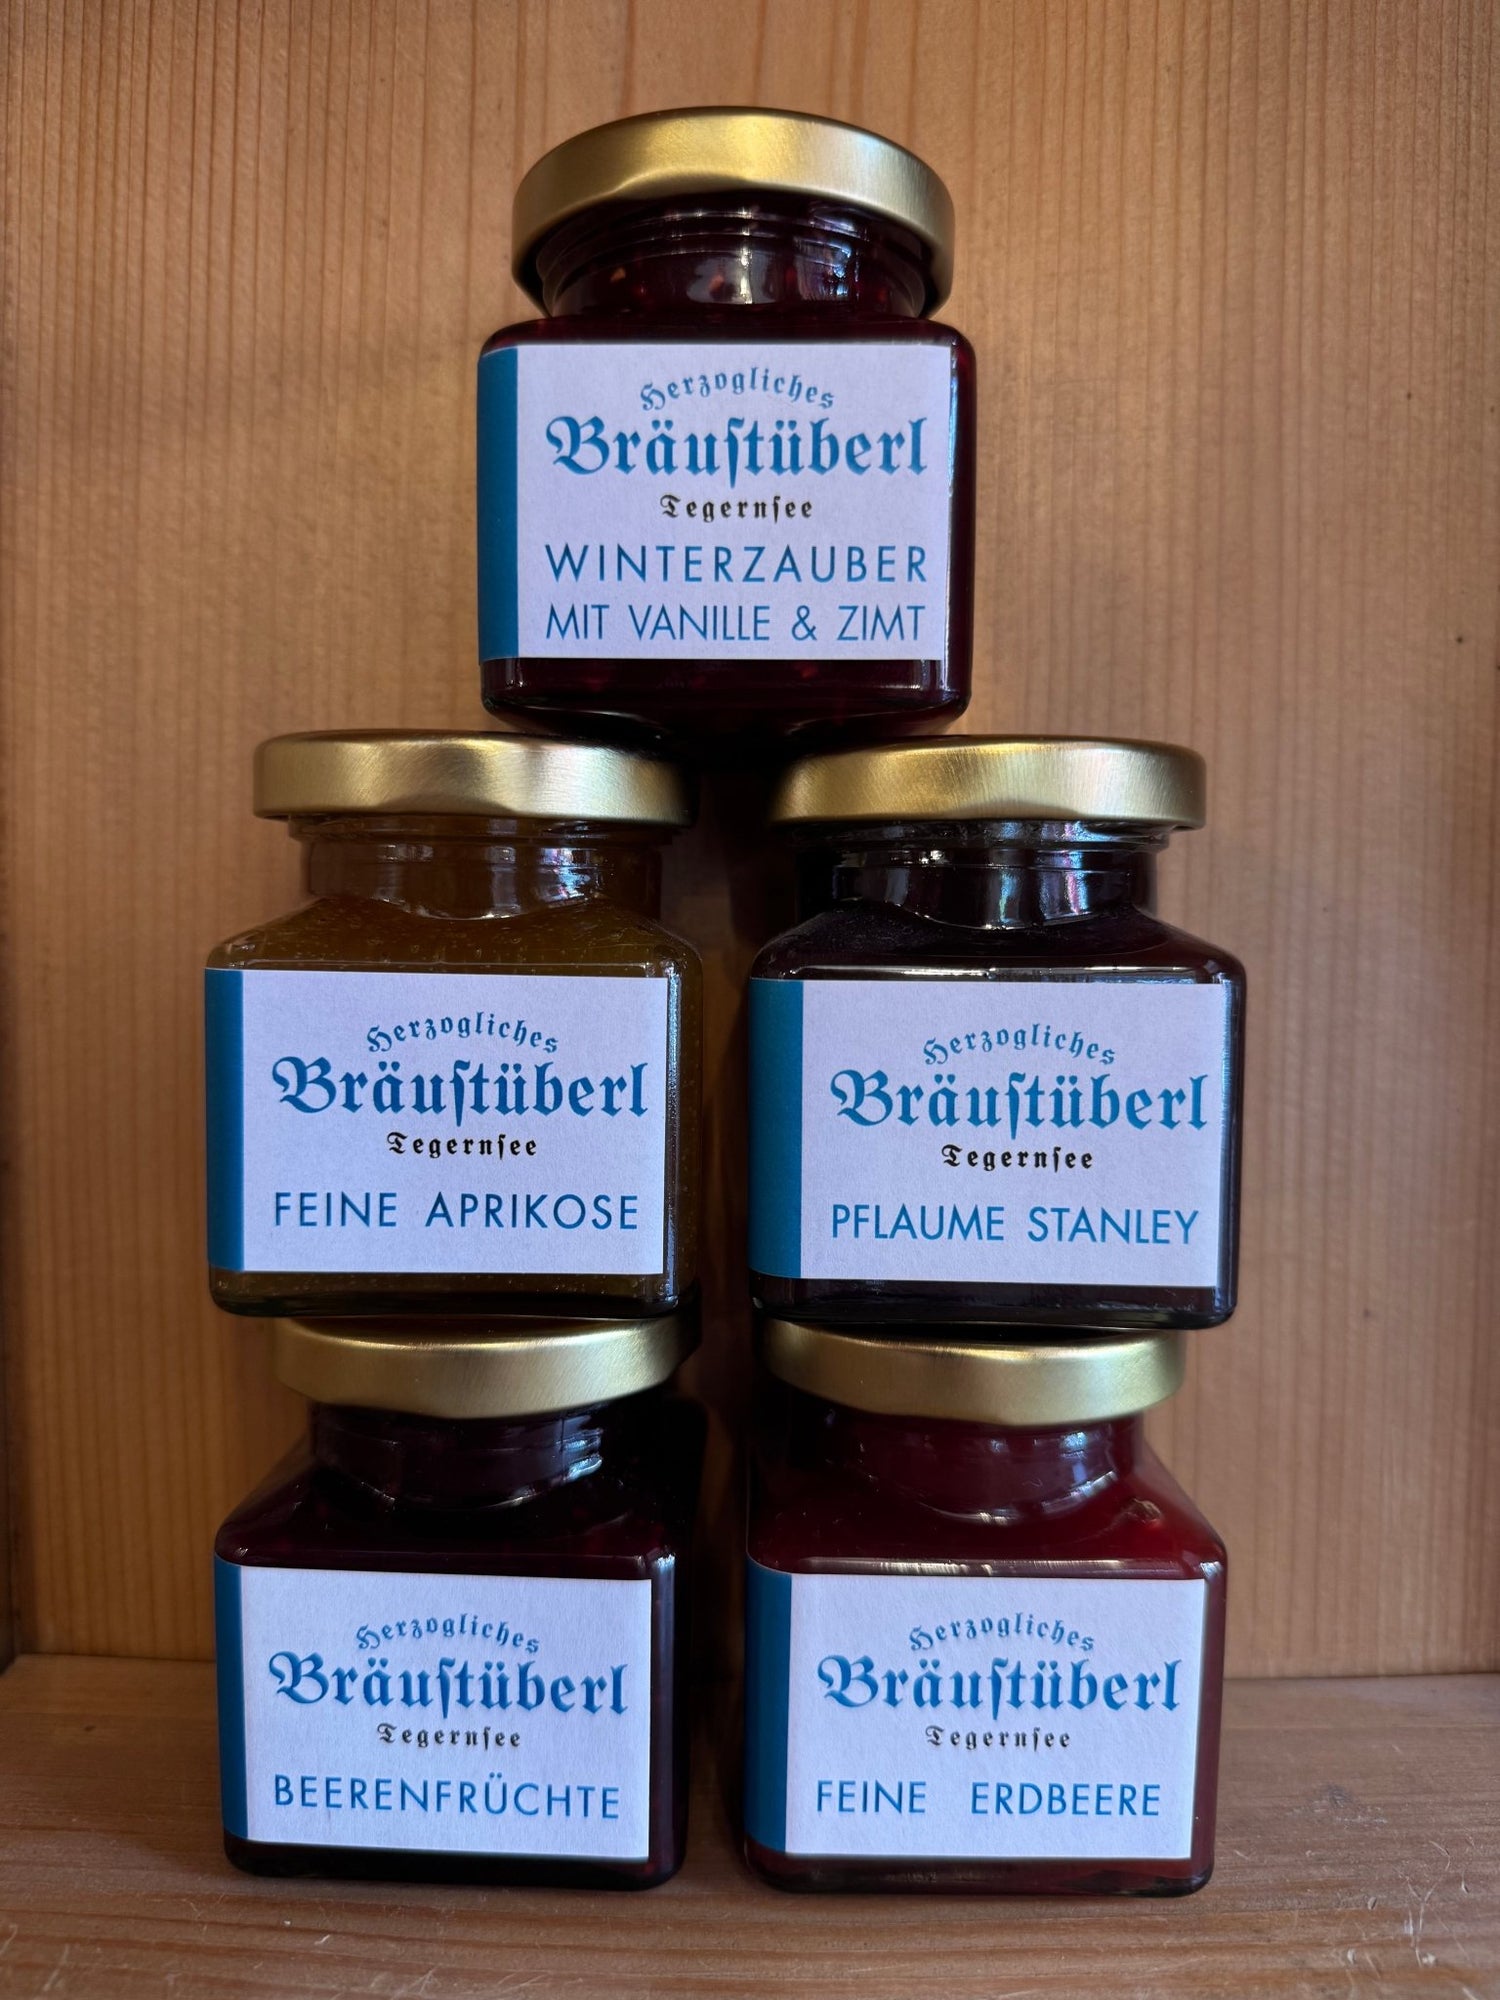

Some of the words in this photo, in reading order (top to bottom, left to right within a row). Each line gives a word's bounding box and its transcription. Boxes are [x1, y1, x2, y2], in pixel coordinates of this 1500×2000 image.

[639, 366, 834, 411] Herzogliches
[659, 494, 813, 524] Tegernsee
[544, 542, 927, 584] WINTERZAUBER
[545, 603, 610, 641] MIT
[627, 603, 771, 642] VANILLE
[790, 604, 818, 642] &
[836, 604, 926, 642] ZIMT
[366, 1011, 559, 1054] Herzogliches
[922, 1023, 1116, 1067] Herzogliches
[386, 1131, 537, 1161] Tegernsee
[941, 1143, 1093, 1174] Tegernsee
[274, 1190, 398, 1228] FEINE
[424, 1191, 638, 1231] APRIKOSE
[832, 1202, 1005, 1242] PFLAUME
[1027, 1205, 1200, 1245] STANLEY
[355, 1612, 540, 1656] Herzogliches
[908, 1612, 1095, 1653] Herzogliches
[376, 1722, 522, 1751] Tegernsee
[925, 1725, 1071, 1752] Tegernsee
[274, 1771, 620, 1820] BEERENFRÜCHTE
[816, 1779, 927, 1815] FEINE
[970, 1781, 1161, 1817] ERDBEERE
